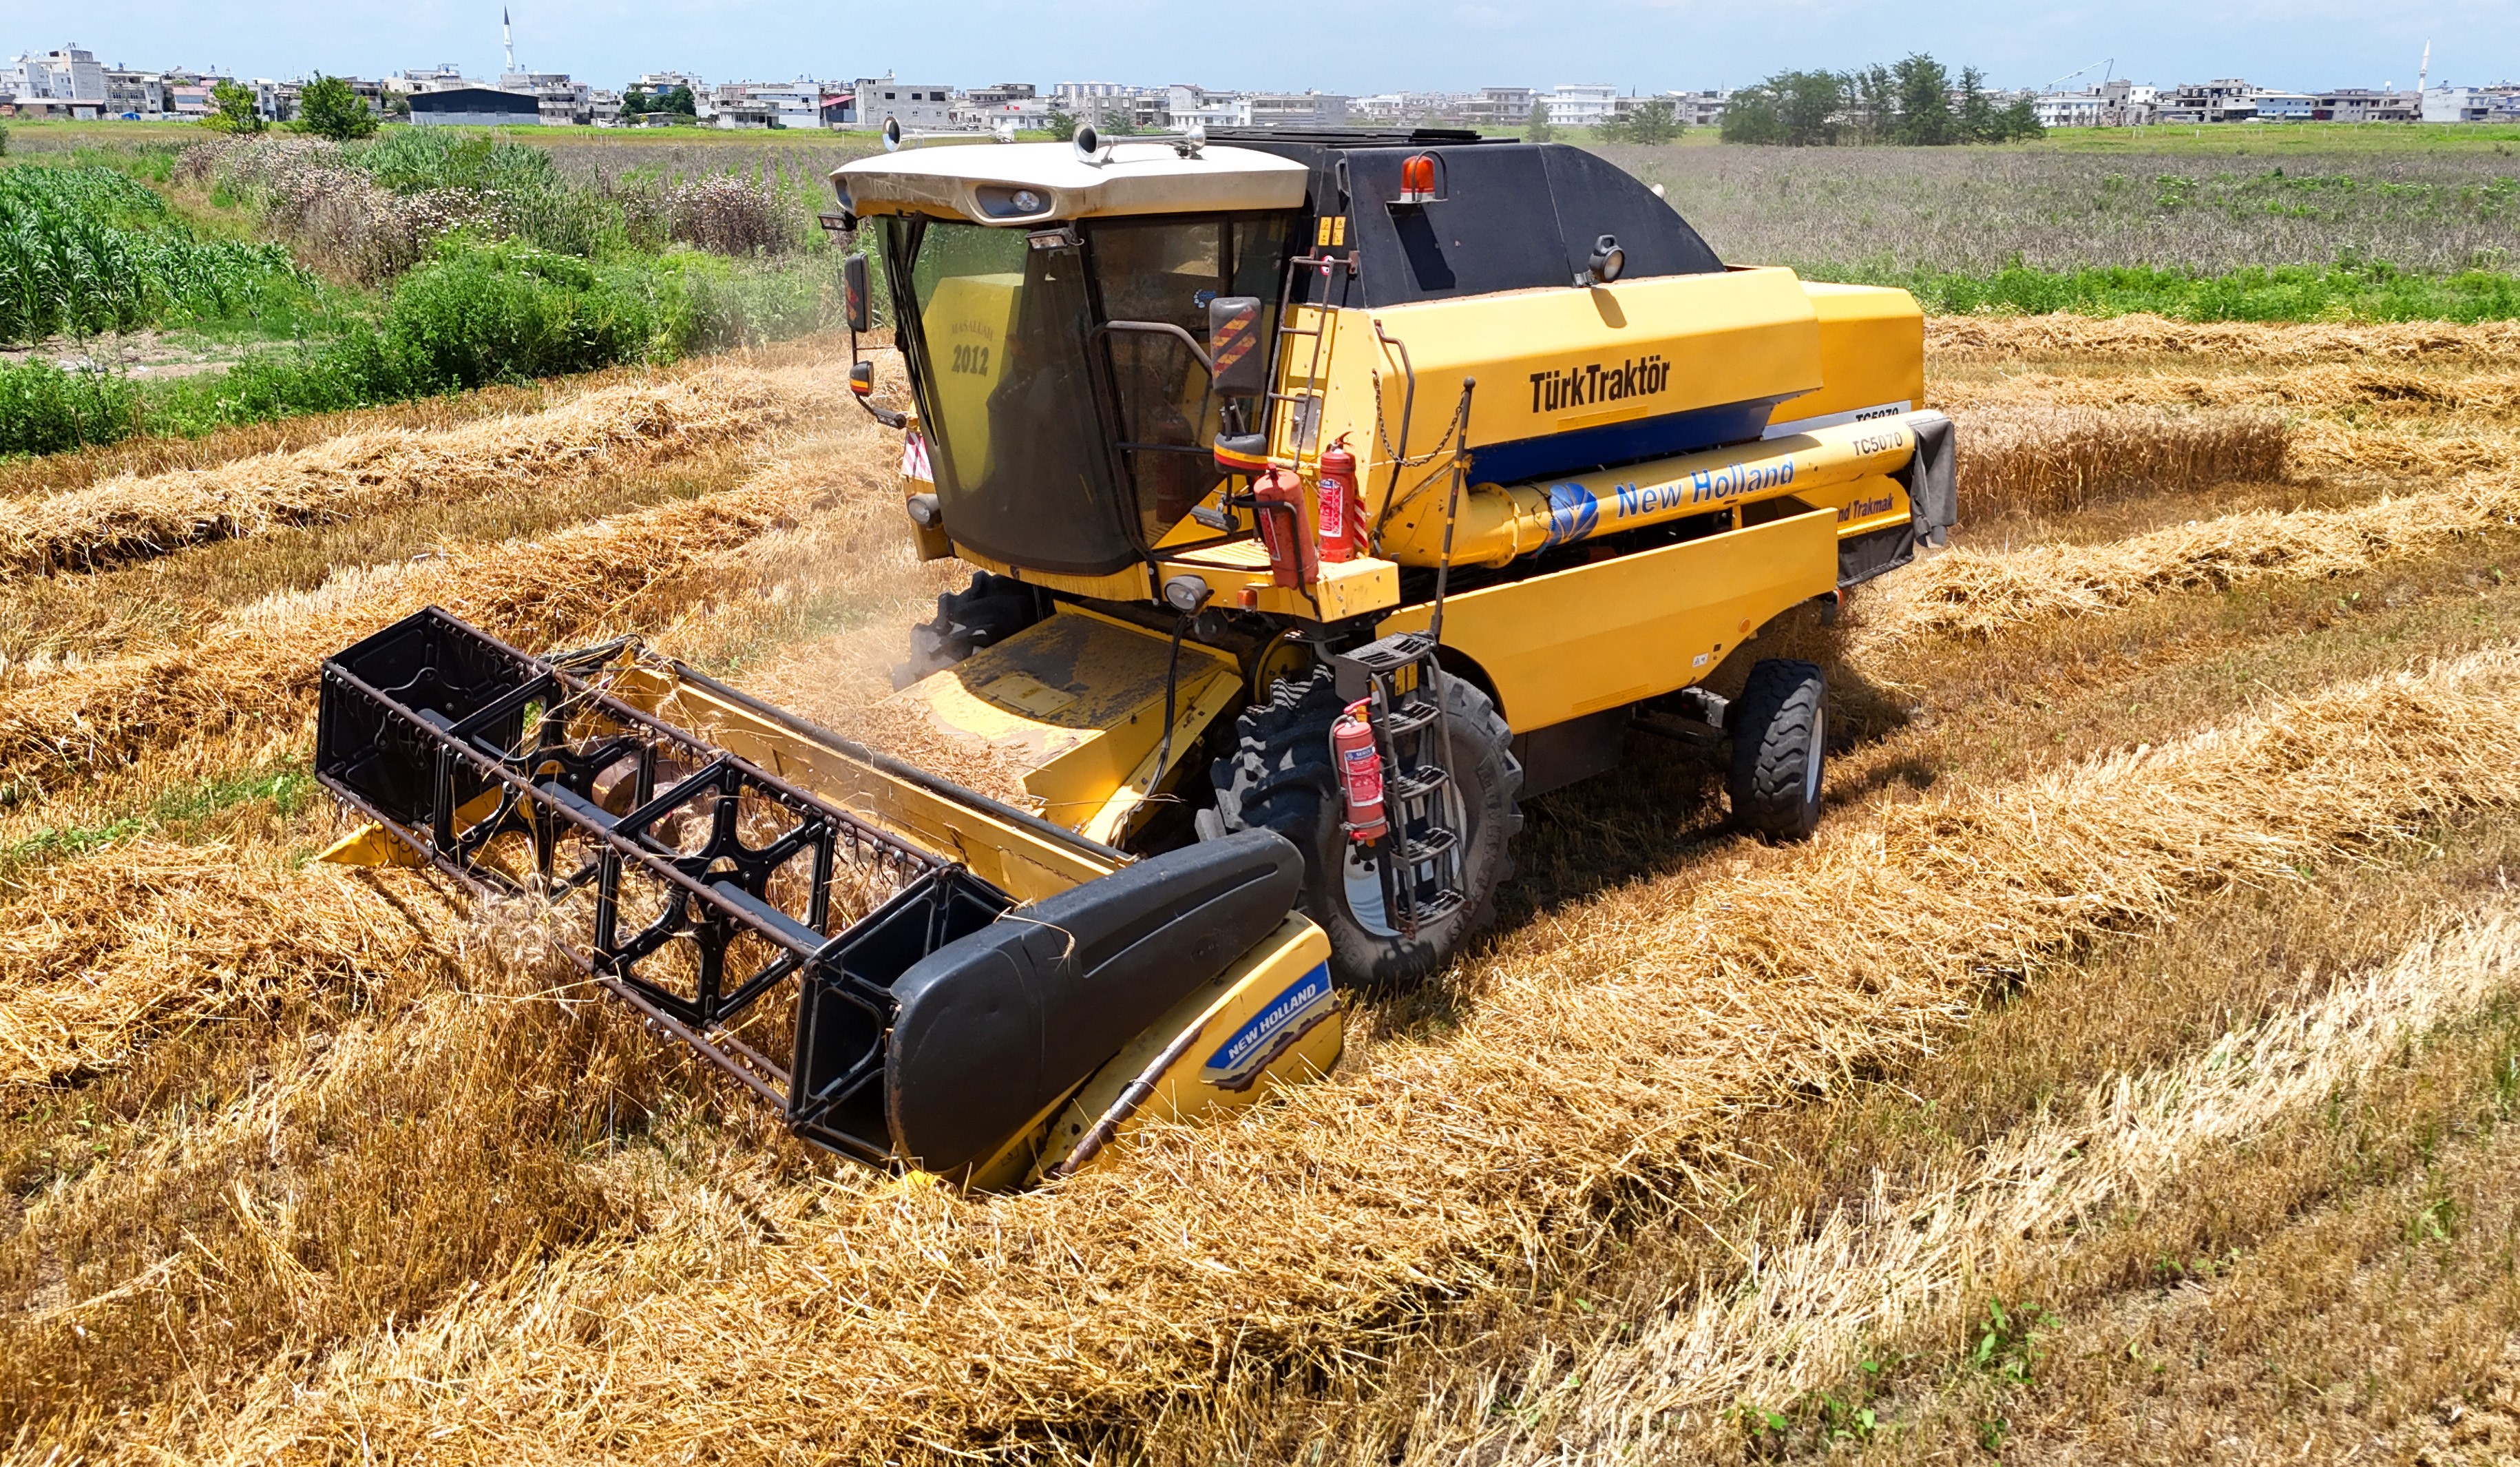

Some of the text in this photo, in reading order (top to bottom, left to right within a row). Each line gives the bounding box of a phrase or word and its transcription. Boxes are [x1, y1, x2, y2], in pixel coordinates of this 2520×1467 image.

[952, 344, 989, 377] 2012
[1530, 355, 1670, 413] TürkTraktör
[1852, 432, 1902, 456] TC5070
[1615, 453, 1794, 518] New Holland
[1854, 493, 1893, 519] Trakmak
[1228, 984, 1316, 1059] NEW HOLLAND
